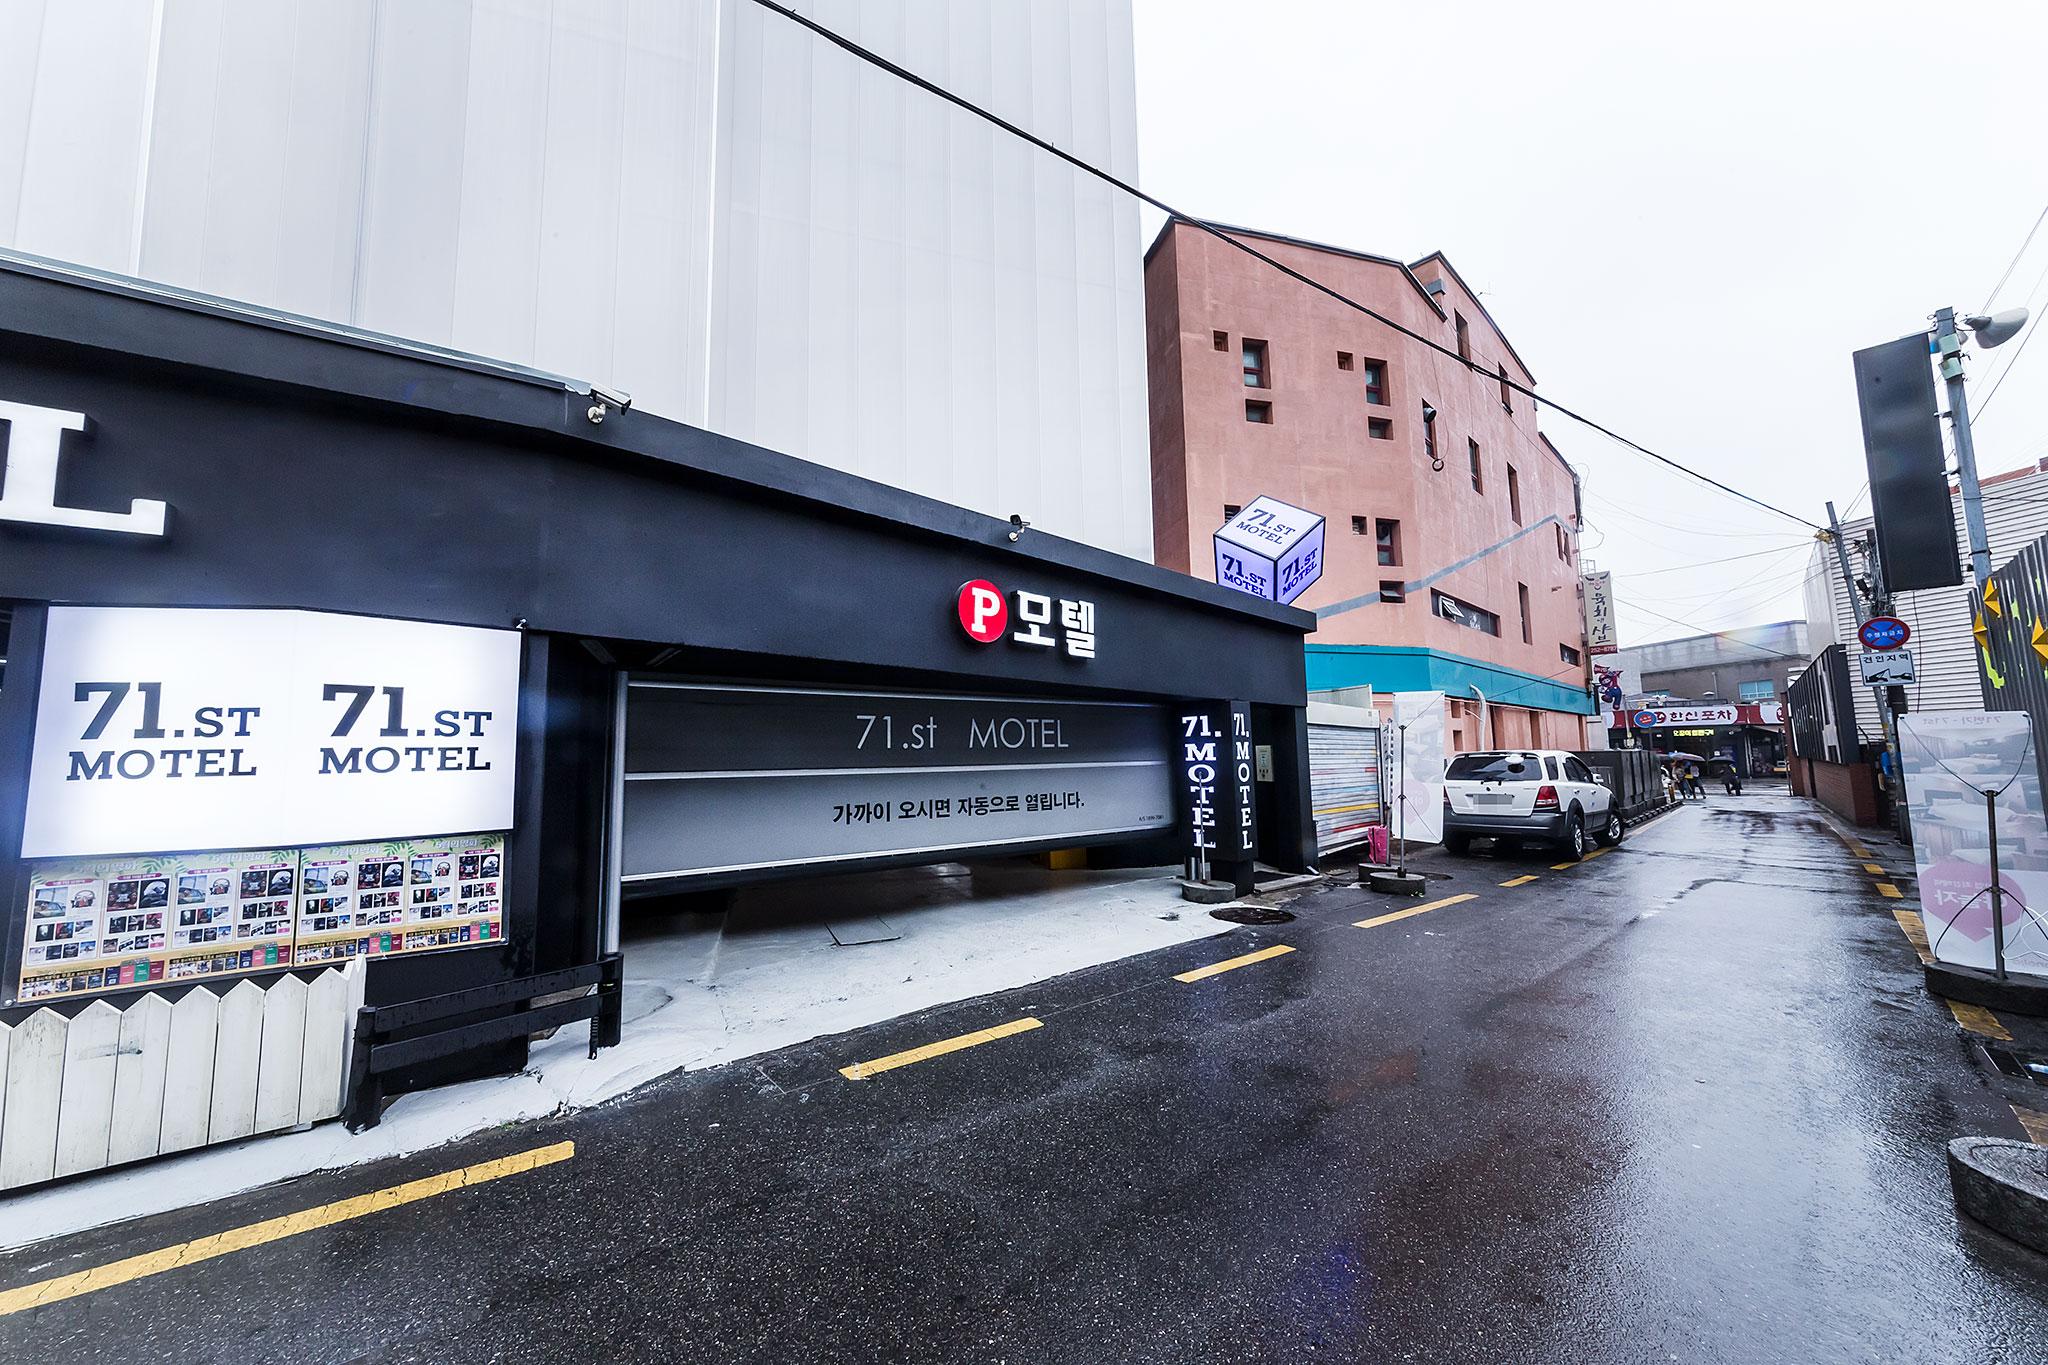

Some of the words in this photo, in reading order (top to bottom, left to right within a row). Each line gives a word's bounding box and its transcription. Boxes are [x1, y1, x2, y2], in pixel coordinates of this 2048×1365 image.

[1236, 521, 1283, 545] MOTEL
[1247, 508, 1296, 536] 71.ST
[1222, 553, 1267, 587] 71.ST
[1281, 561, 1318, 596] MOTEL
[1282, 547, 1318, 585] 71.ST
[1223, 571, 1267, 599] MOTEL
[971, 587, 1001, 633] P
[1013, 590, 1096, 659] 모텔
[1863, 653, 1909, 663] 견인지역
[74, 682, 261, 740] 71.ST
[322, 684, 493, 738] 71.ST
[1181, 715, 1222, 738] 71.
[1233, 713, 1250, 738] 71.
[1669, 709, 1732, 722] 한신포차
[856, 715, 938, 750] 71.st
[969, 718, 1069, 749] MOTEL
[66, 749, 258, 781] MOTEL
[319, 746, 491, 774] MOTEL
[833, 801, 891, 825] 가까이
[898, 798, 951, 820] 오시면
[957, 795, 1021, 817] 자동으로
[1025, 791, 1085, 812] 열립니다.
[1184, 742, 1217, 849] MOTEL
[1235, 741, 1253, 850] MOTEL
